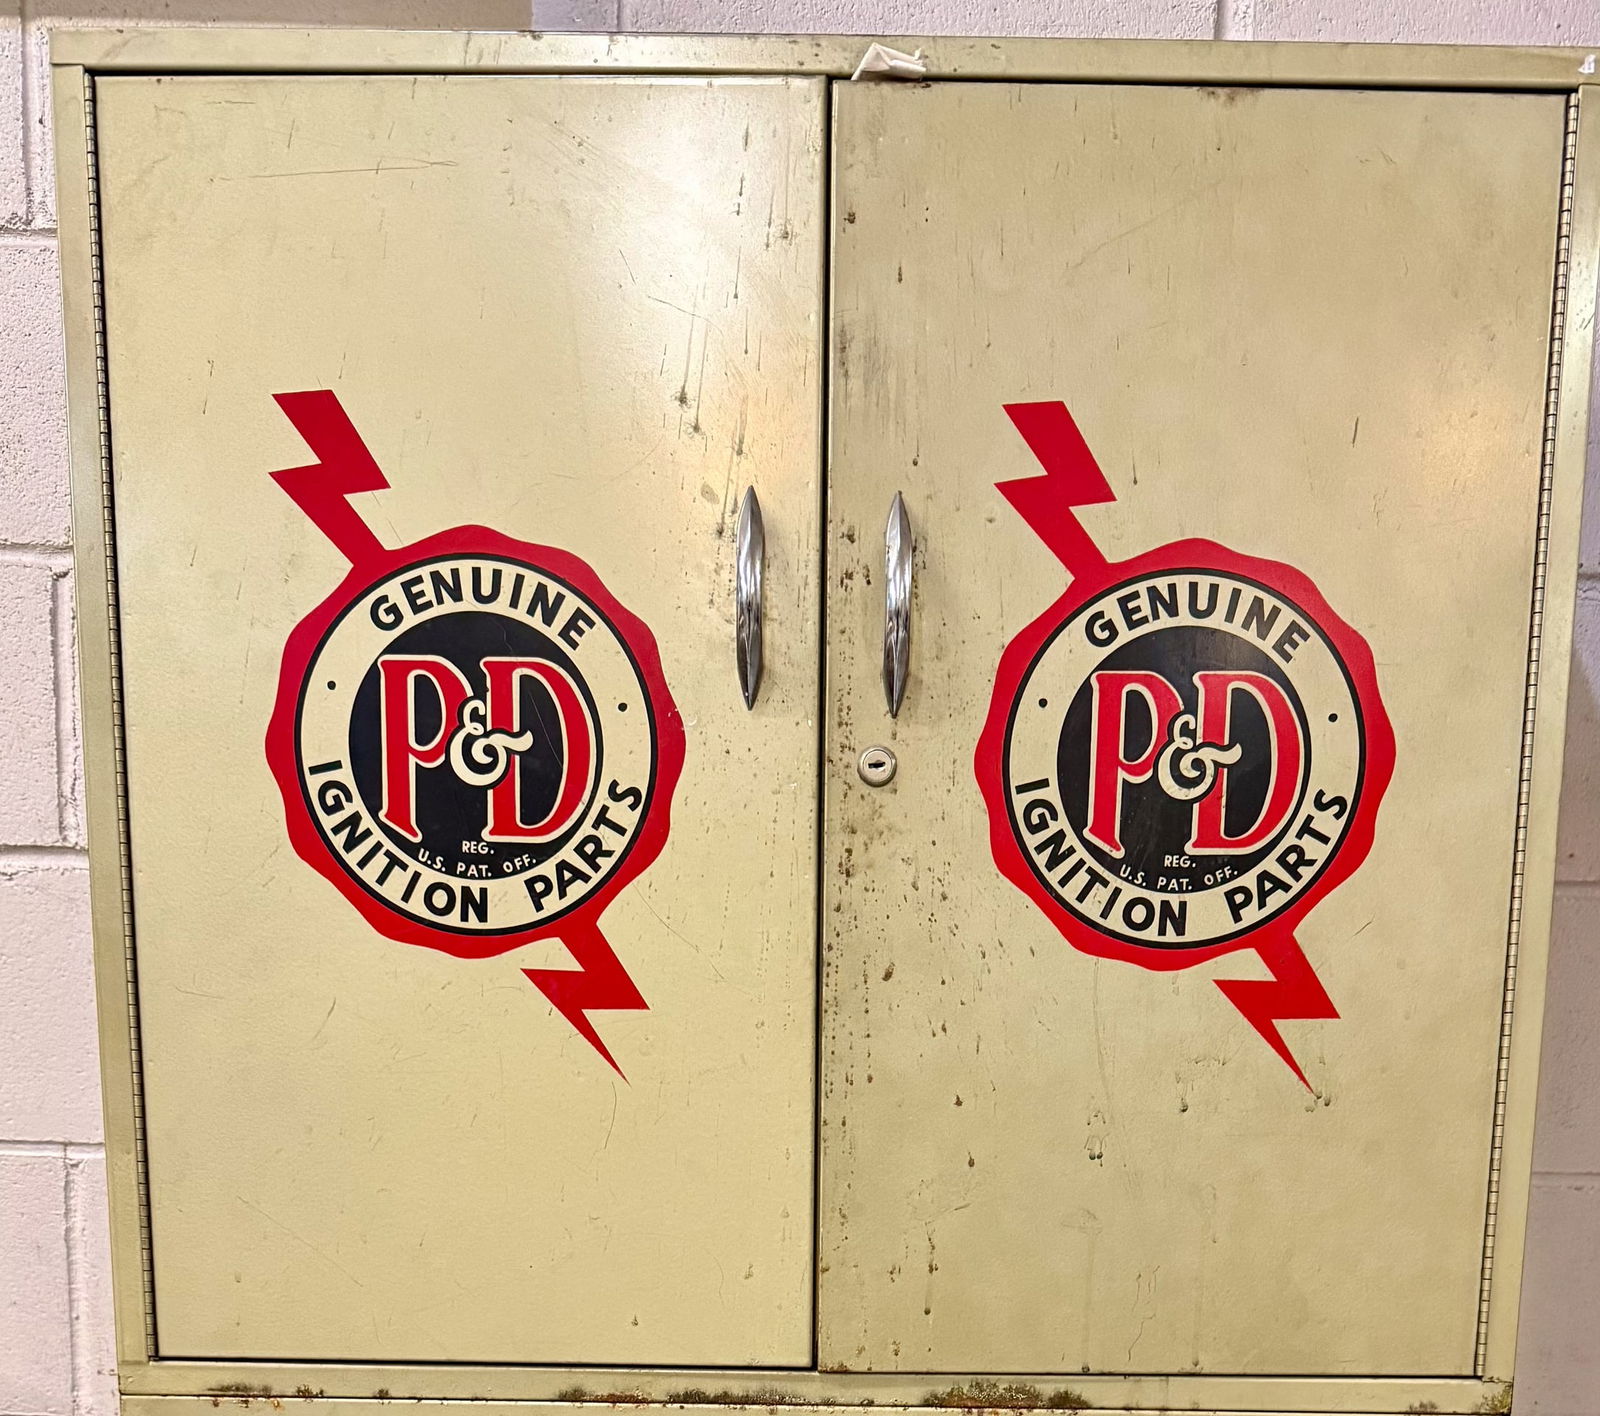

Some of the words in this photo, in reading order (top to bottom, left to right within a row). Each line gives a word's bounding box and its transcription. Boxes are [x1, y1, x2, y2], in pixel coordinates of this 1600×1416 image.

[370, 567, 595, 650] GENUINE
[1084, 581, 1310, 664] GENUINE
[378, 654, 598, 843] P&D
[1084, 670, 1305, 857] P&D
[308, 759, 488, 923] IGNITION
[524, 779, 642, 912] PARTS
[418, 848, 446, 872] U.S.
[457, 861, 492, 877] PAT.
[502, 854, 537, 873] OFF.
[462, 840, 495, 854] REG.
[1015, 778, 1187, 937] IGNITION
[1224, 788, 1347, 924] PARTS
[1119, 864, 1147, 887] U.S.
[1157, 876, 1193, 891] PAT.
[1204, 866, 1239, 885] OFF.
[1164, 854, 1196, 868] REG.
